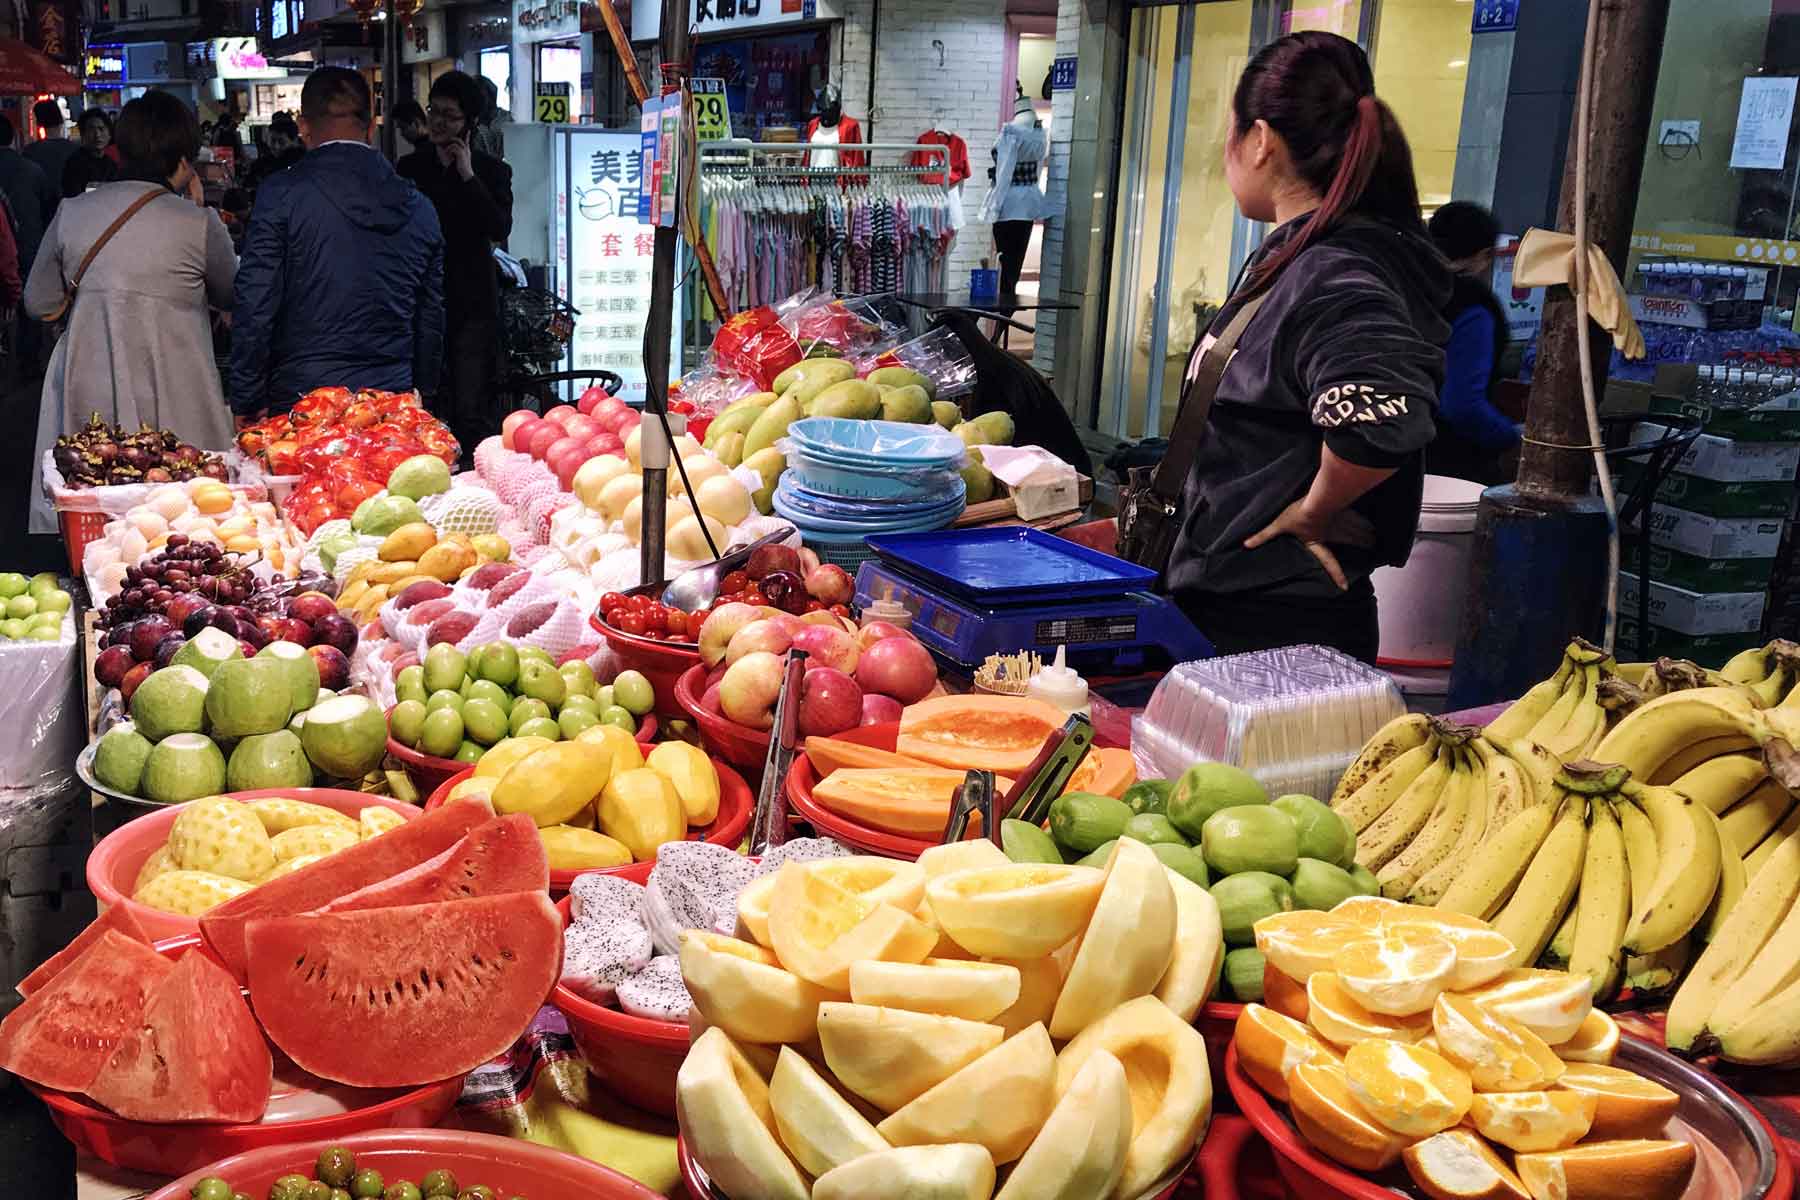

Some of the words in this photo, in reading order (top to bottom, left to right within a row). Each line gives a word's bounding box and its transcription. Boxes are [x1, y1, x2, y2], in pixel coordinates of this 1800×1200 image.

[539, 98, 566, 122] 29
[694, 97, 723, 126] 29
[601, 233, 654, 257] 套餐
